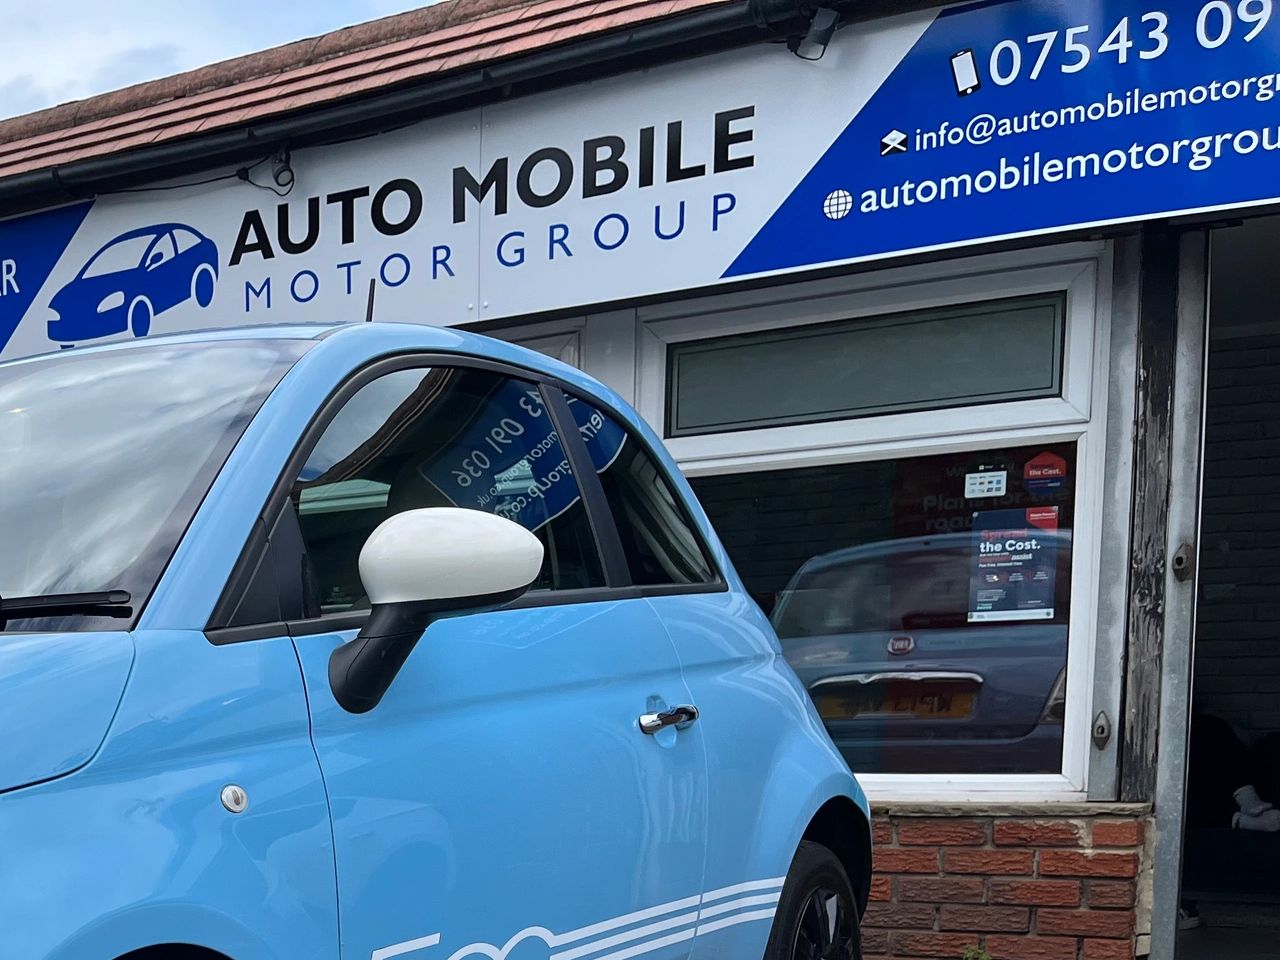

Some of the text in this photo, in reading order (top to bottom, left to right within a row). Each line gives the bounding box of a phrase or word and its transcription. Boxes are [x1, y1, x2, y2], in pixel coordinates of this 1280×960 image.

[989, 0, 1272, 86] 07543 09
[228, 105, 756, 266] AUTO MOBILE
[860, 126, 1280, 214] automobilemotorgrou
[246, 193, 737, 312] MOTOR GROUP
[979, 539, 1041, 553] the Cost.
